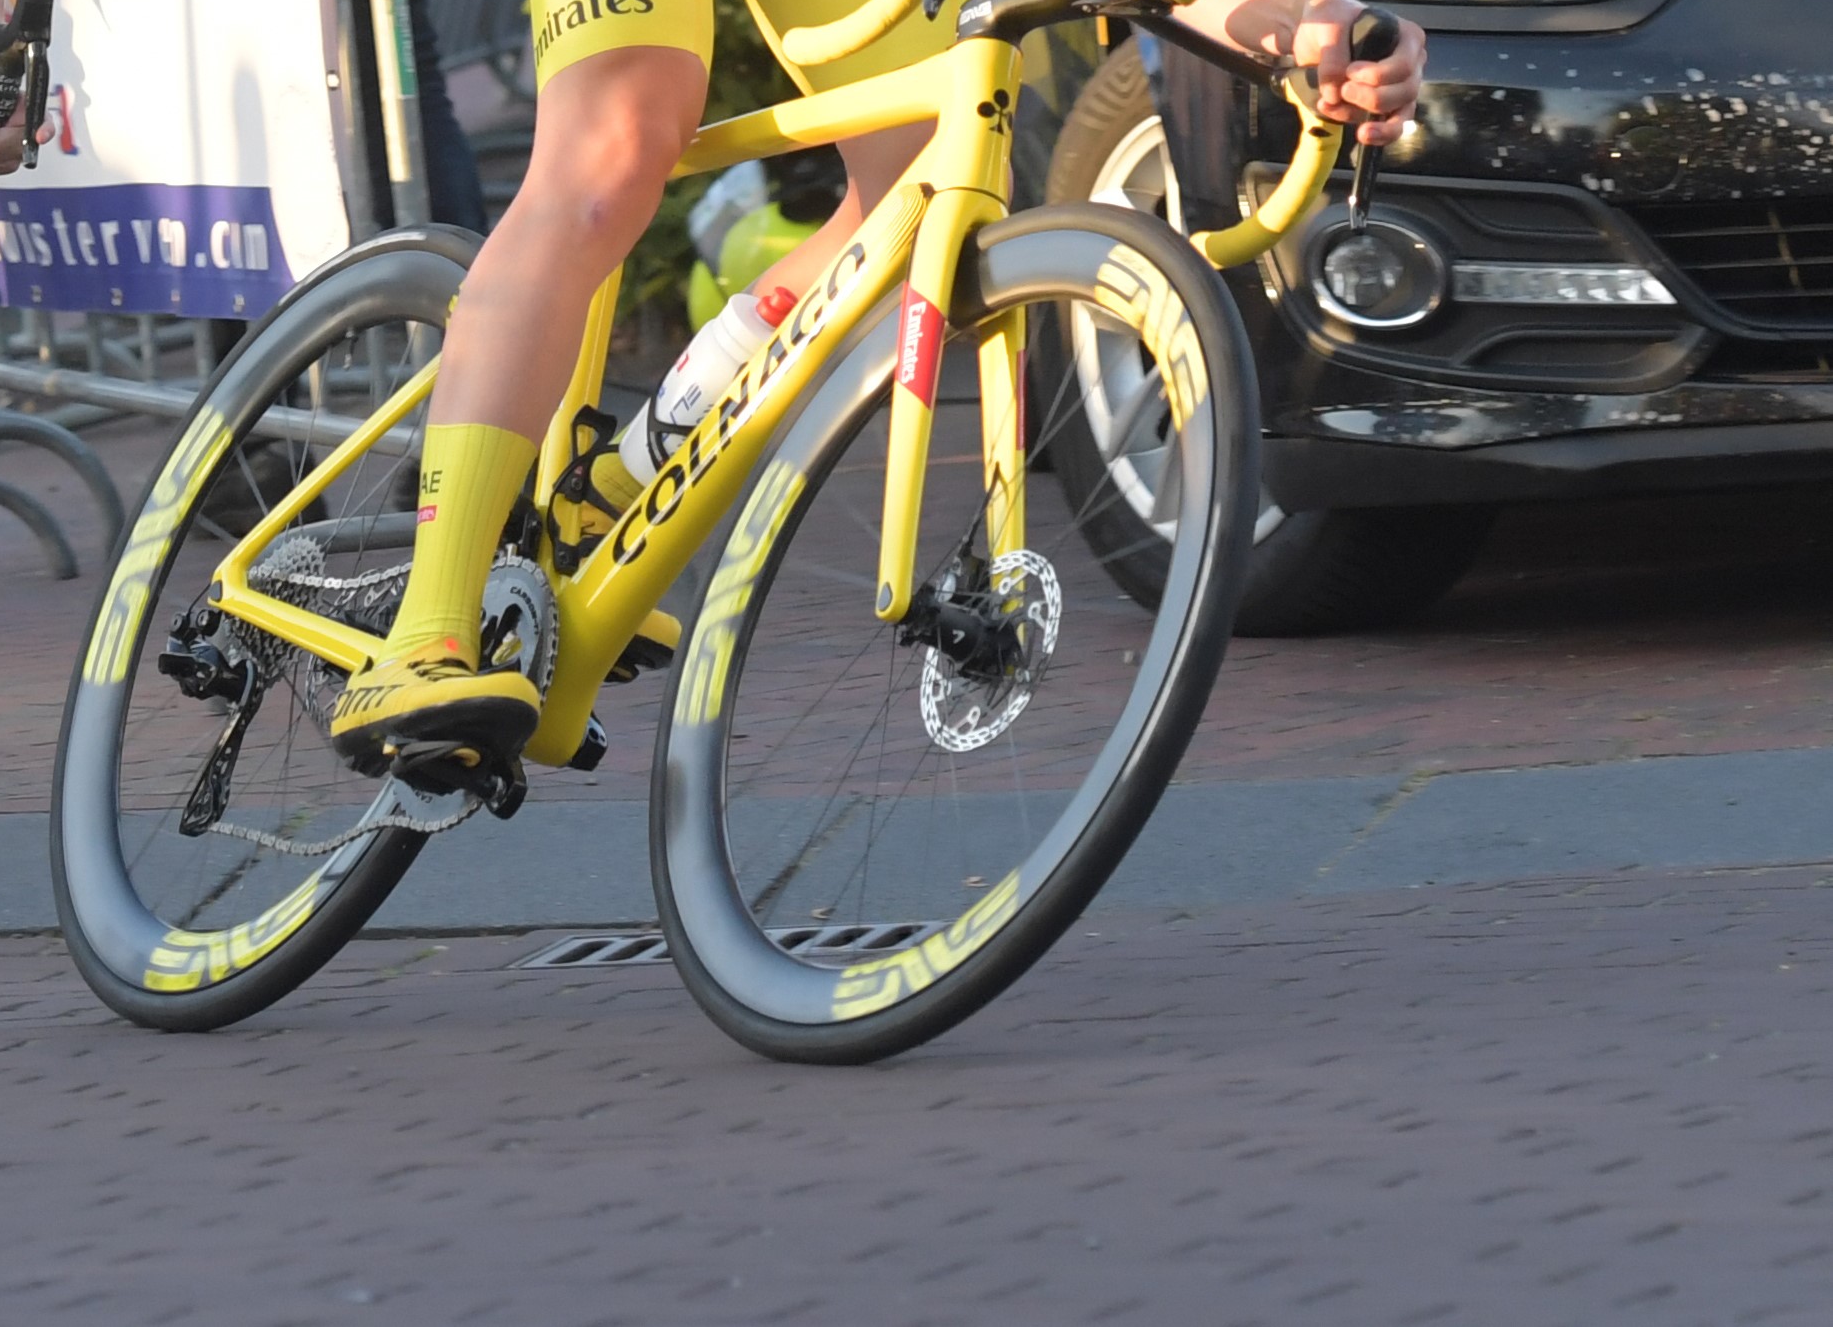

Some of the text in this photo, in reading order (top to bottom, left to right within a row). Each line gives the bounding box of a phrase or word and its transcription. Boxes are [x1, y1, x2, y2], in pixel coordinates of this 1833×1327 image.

[901, 300, 928, 385] Emirates
[612, 242, 867, 566] COLNAGO
[420, 470, 443, 494] AE
